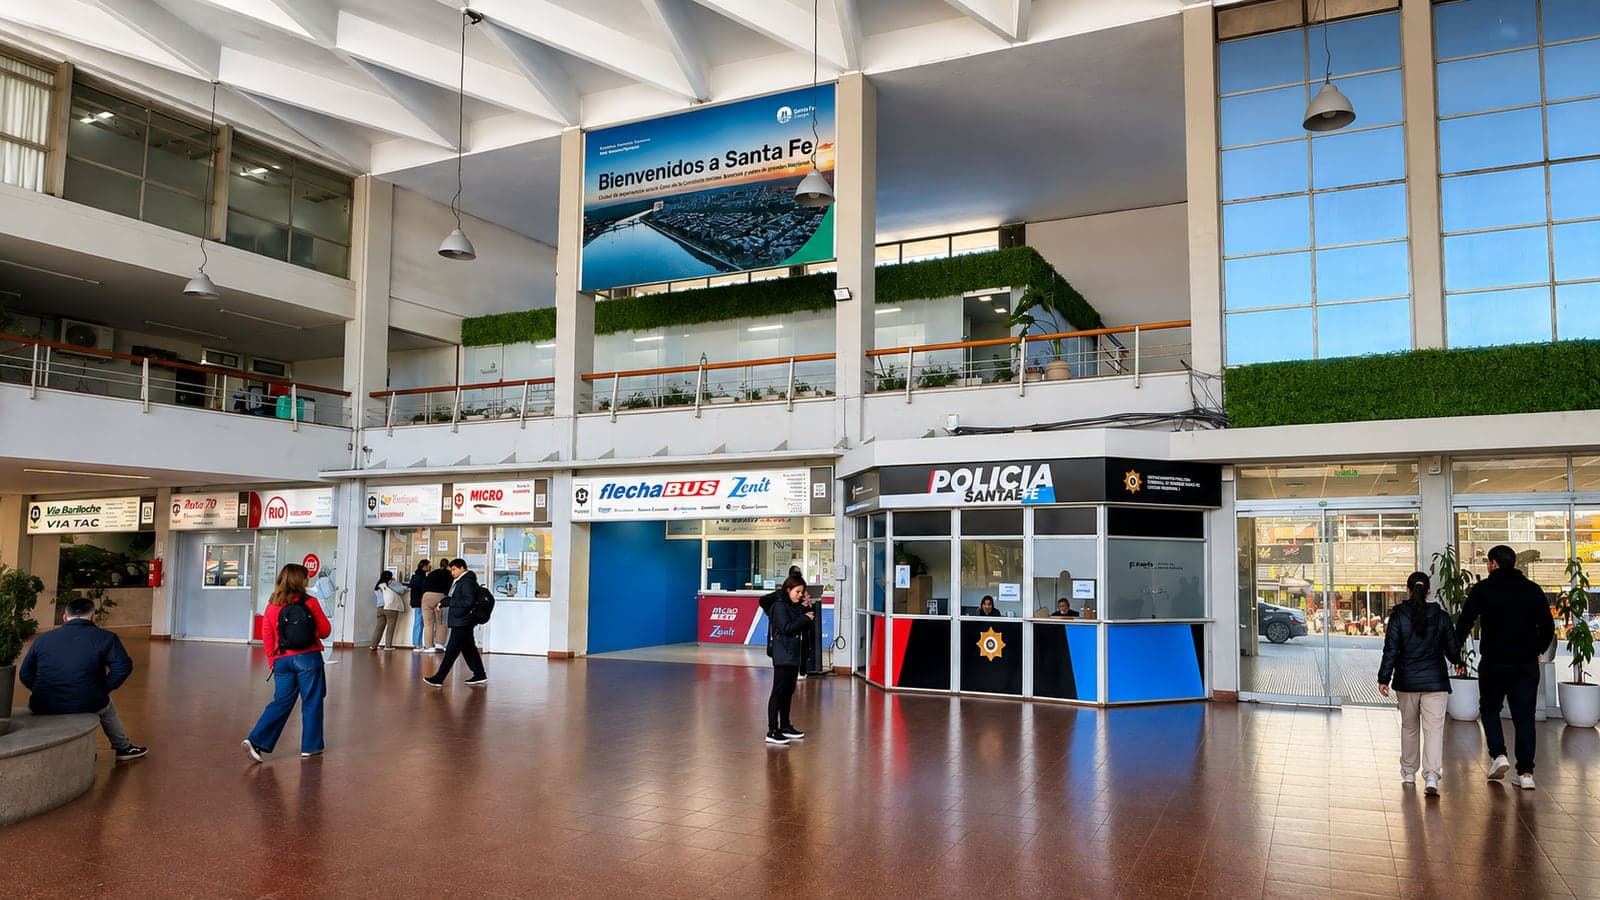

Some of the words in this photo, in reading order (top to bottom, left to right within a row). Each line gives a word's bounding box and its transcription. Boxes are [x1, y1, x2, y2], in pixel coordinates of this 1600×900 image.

[599, 158, 704, 191] Bienvenidos
[709, 157, 719, 171] a
[725, 144, 783, 168] Santa
[789, 138, 813, 157] Fe
[931, 463, 1054, 494] POLICIA
[599, 480, 719, 500] flechaBUS
[727, 476, 771, 499] Zenit
[470, 489, 503, 502] MICRO
[47, 506, 60, 515] Via
[61, 504, 102, 514] Bariloche
[205, 498, 217, 510] 70
[268, 507, 285, 519] RIO
[47, 520, 69, 529] VIA
[73, 518, 99, 528] TAC
